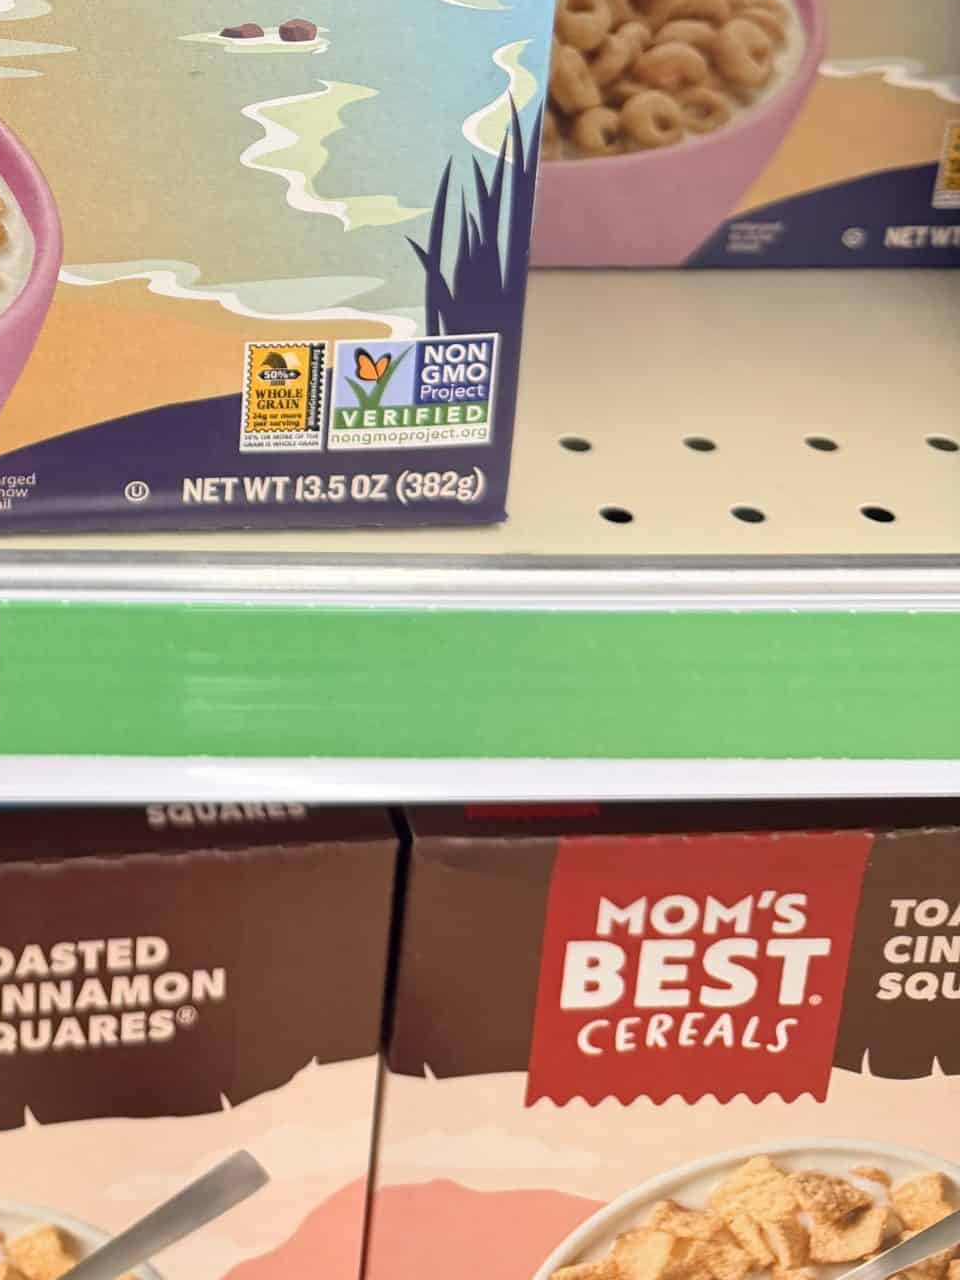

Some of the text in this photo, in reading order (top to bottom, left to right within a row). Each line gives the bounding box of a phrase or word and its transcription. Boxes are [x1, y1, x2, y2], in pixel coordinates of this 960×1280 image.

[424, 342, 488, 365] NON
[422, 363, 487, 384] GMO
[255, 388, 303, 399] WHOLE
[420, 383, 484, 402] Project
[257, 399, 300, 410] GRAIN
[342, 404, 483, 428] VERIFIED
[331, 425, 488, 446] nongmoproject.org
[182, 466, 485, 505] NET WT 13.5 OZ (382g)
[596, 890, 808, 936] MOM'S
[576, 1011, 798, 1056] CEREALS
